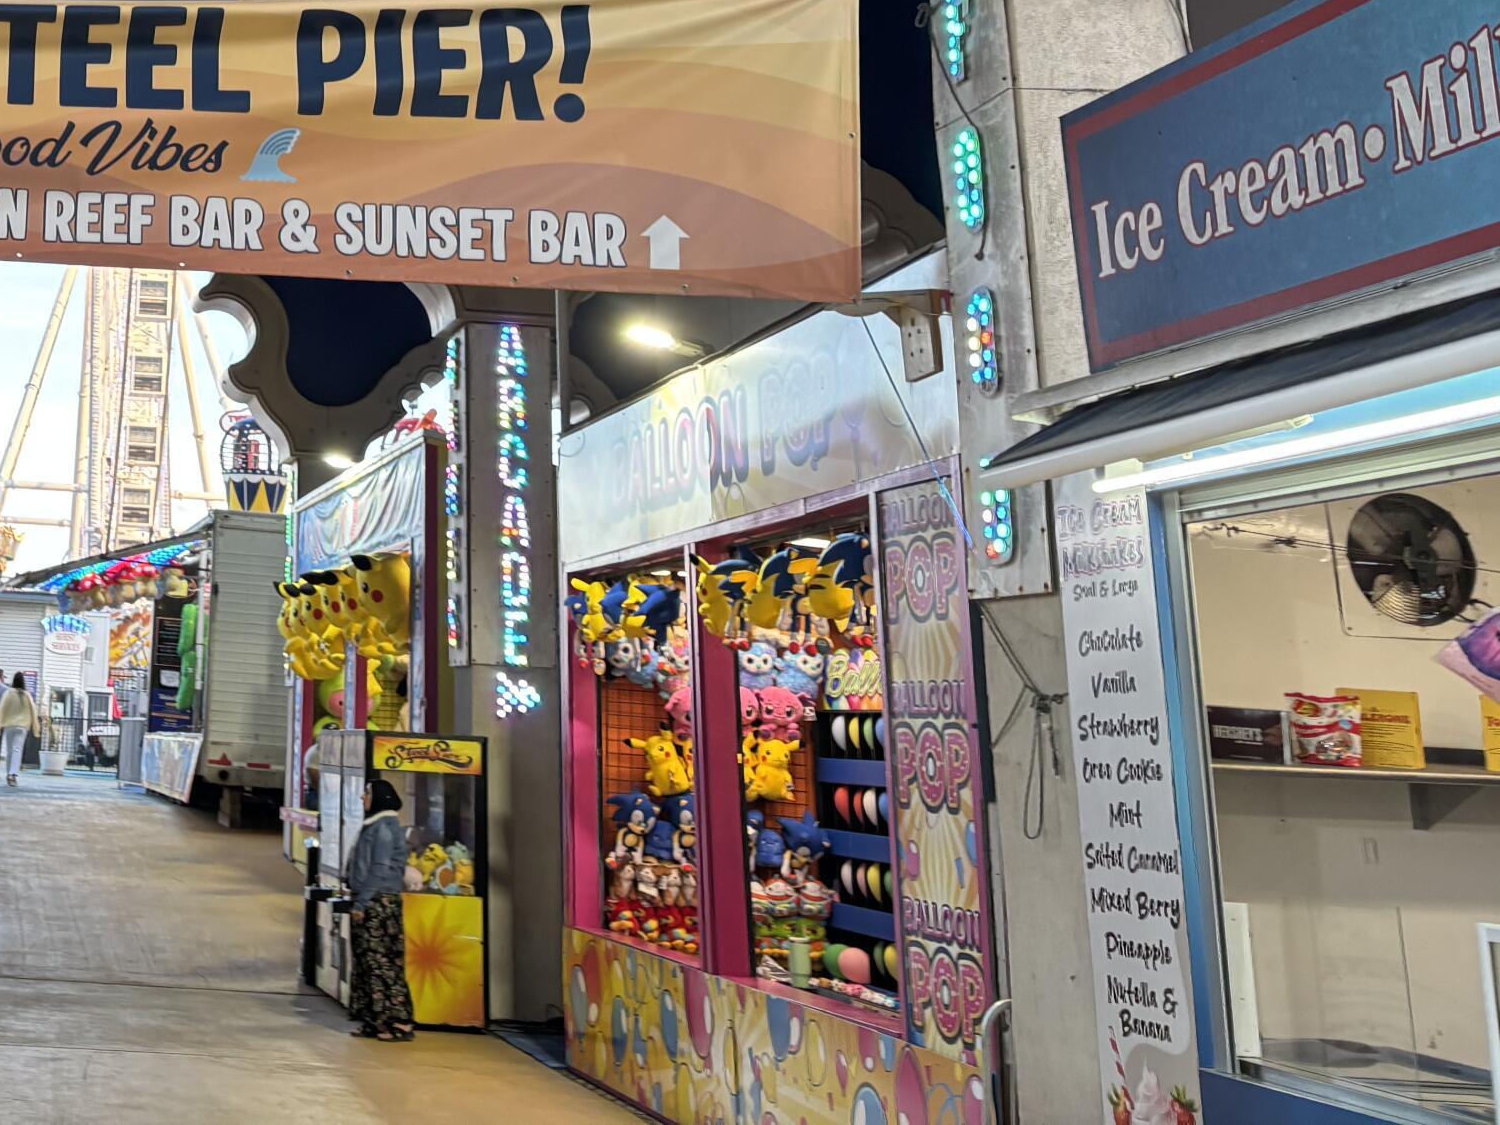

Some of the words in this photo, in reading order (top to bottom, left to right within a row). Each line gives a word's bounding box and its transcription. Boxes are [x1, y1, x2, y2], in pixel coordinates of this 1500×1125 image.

[297, 4, 592, 123] PIER!
[80, 118, 229, 176] Vibes
[1091, 199, 1166, 278] Ice
[1384, 22, 1500, 173] Mil
[43, 190, 155, 245] REEF
[169, 194, 264, 251] BAR
[279, 200, 318, 254] &
[334, 202, 515, 263] SUNSET
[529, 209, 627, 268] BAR
[611, 384, 749, 503] BALLOON
[759, 351, 836, 475] POP
[884, 532, 959, 626] POP
[890, 680, 968, 720] BALLOON
[1092, 670, 1137, 698] Vanilla
[893, 721, 972, 814] POP
[1109, 800, 1143, 828] Mint
[902, 896, 982, 953] BALLOON
[1090, 887, 1132, 915] Mixed
[1135, 891, 1180, 929] Berry
[1105, 931, 1172, 971] Pineapple
[907, 940, 987, 1051] POP
[1106, 975, 1158, 1008] Nutella
[1162, 987, 1179, 1018] &
[1119, 1008, 1172, 1043] Banana
